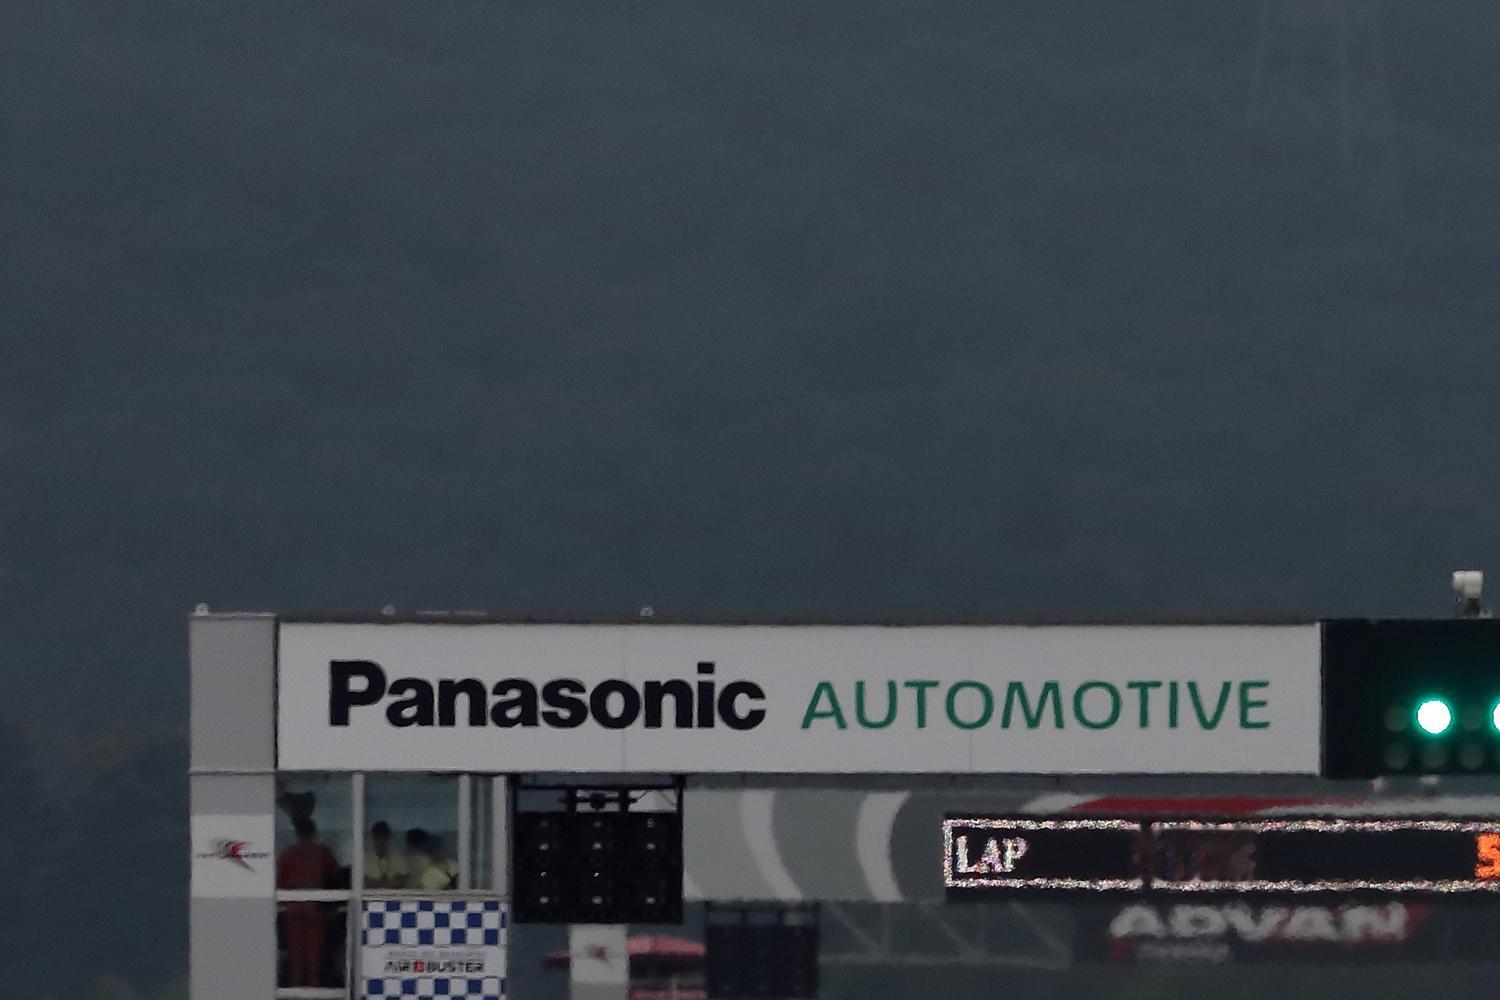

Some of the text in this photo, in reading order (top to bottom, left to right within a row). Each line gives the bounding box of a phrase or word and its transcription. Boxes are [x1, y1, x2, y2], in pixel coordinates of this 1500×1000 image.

[329, 659, 1271, 731] Panasonic AUTOMOTIVE
[955, 834, 1029, 874] LAP
[1108, 902, 1408, 940] ADVAN
